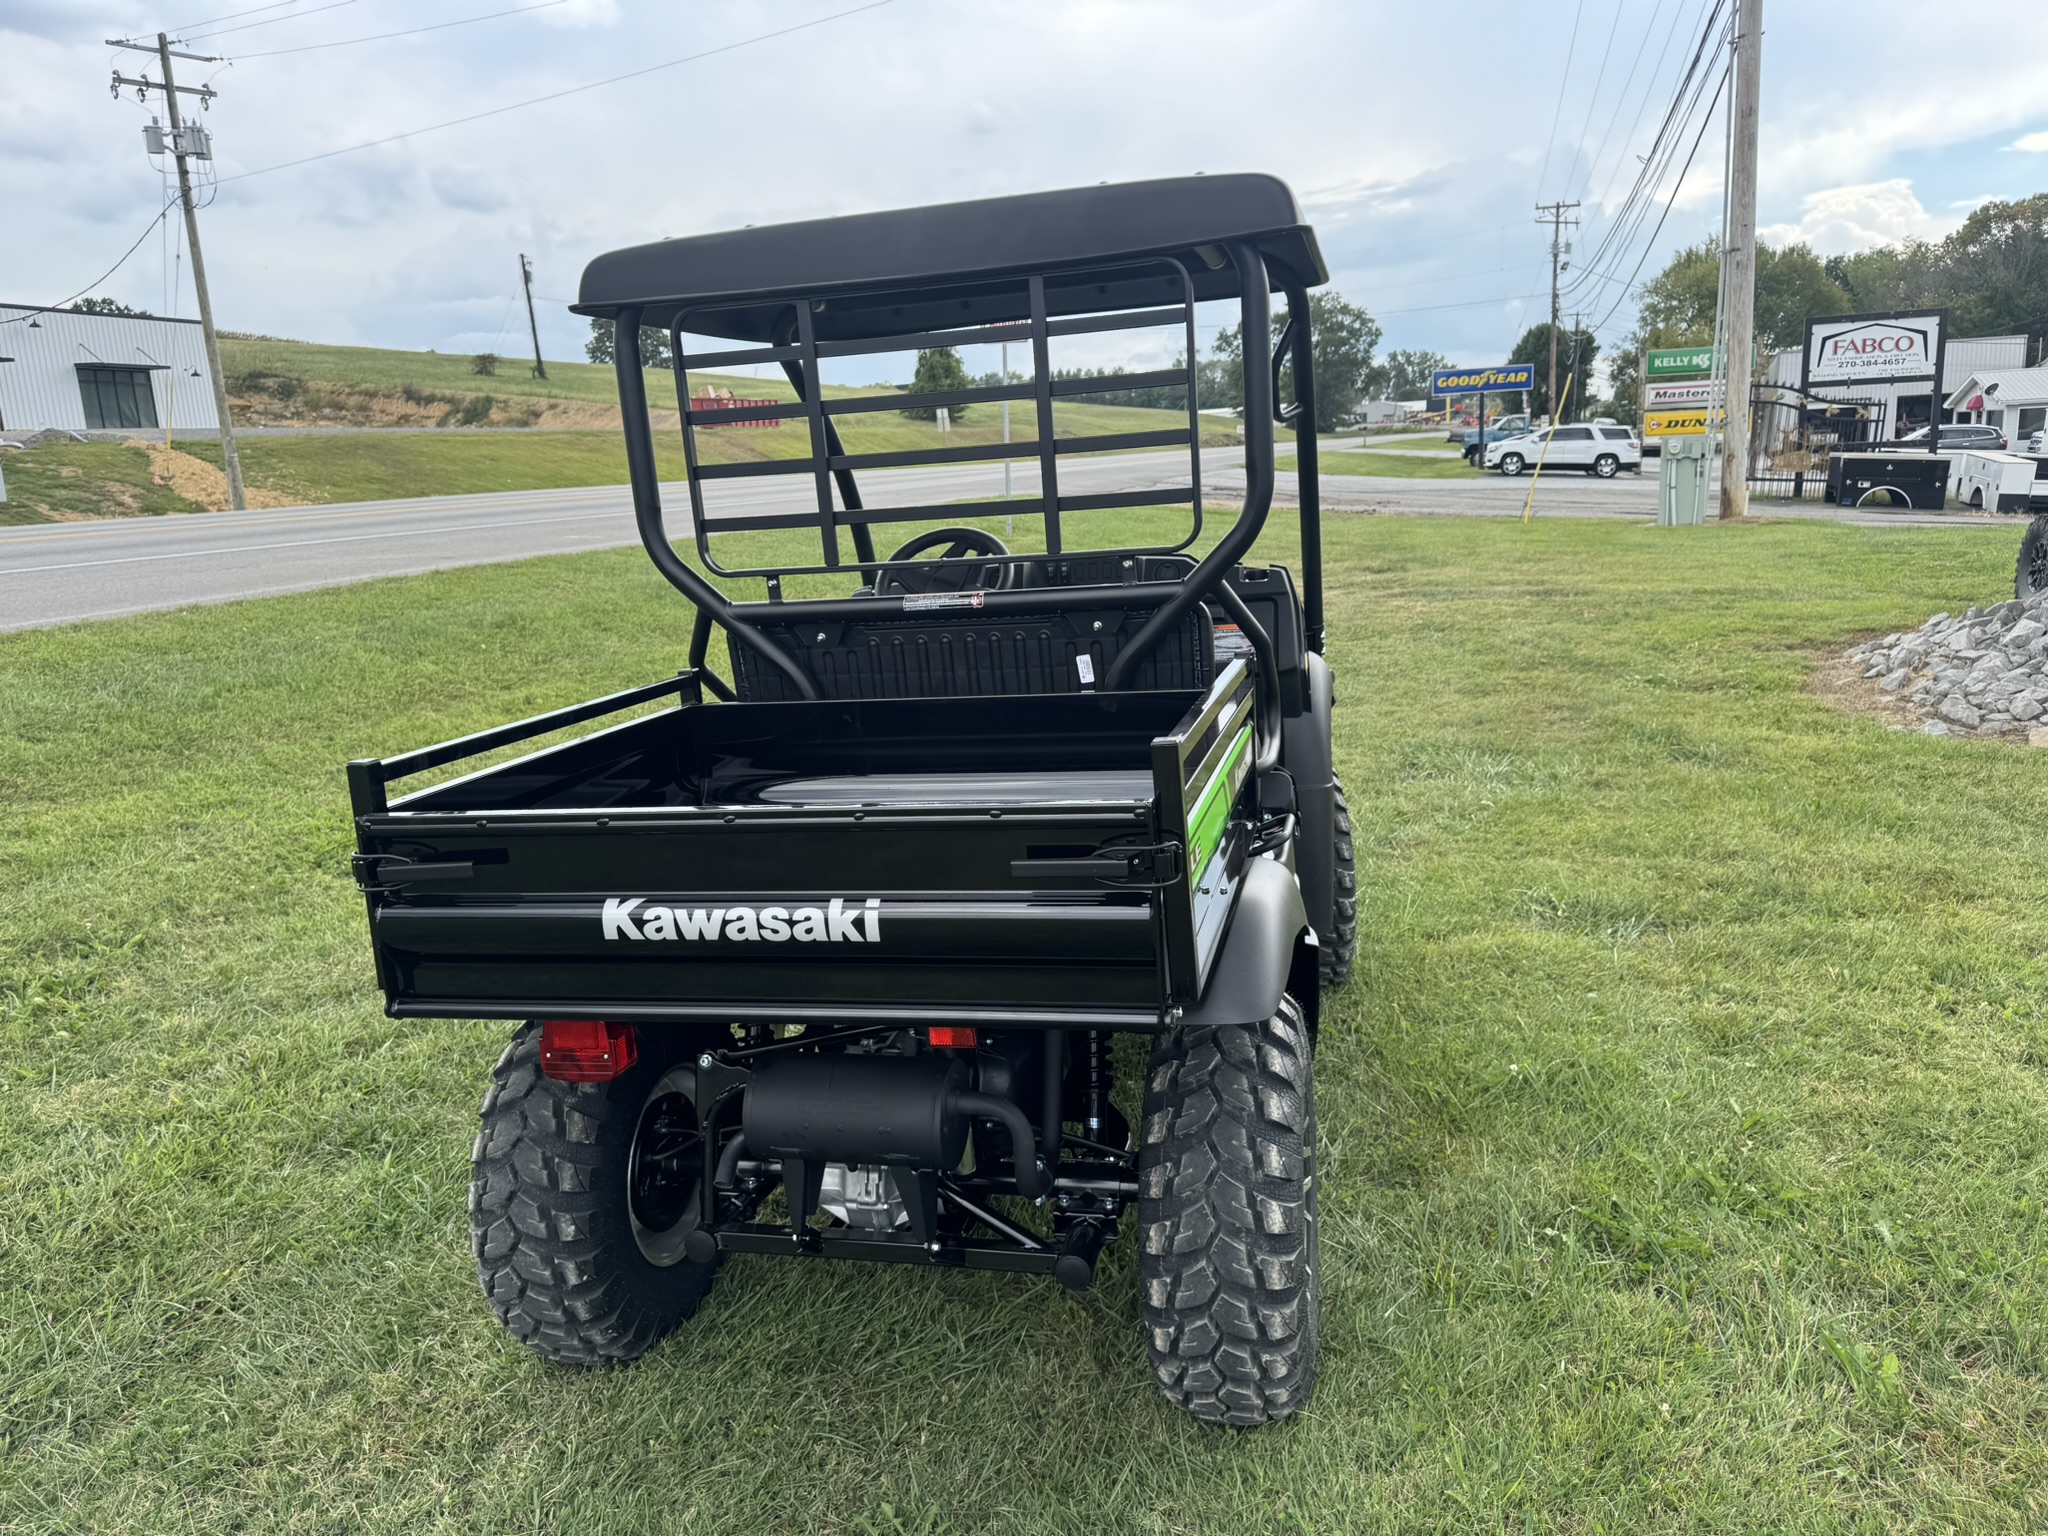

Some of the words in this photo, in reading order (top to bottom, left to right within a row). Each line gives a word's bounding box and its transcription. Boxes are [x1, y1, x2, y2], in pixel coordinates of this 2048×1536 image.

[1833, 336, 1914, 355] FABCO
[1654, 356, 1690, 368] KELLY
[1838, 358, 1907, 369] 270-384-4657
[1437, 371, 1528, 387] GOODYEAR
[601, 898, 881, 942] Kawasaki
